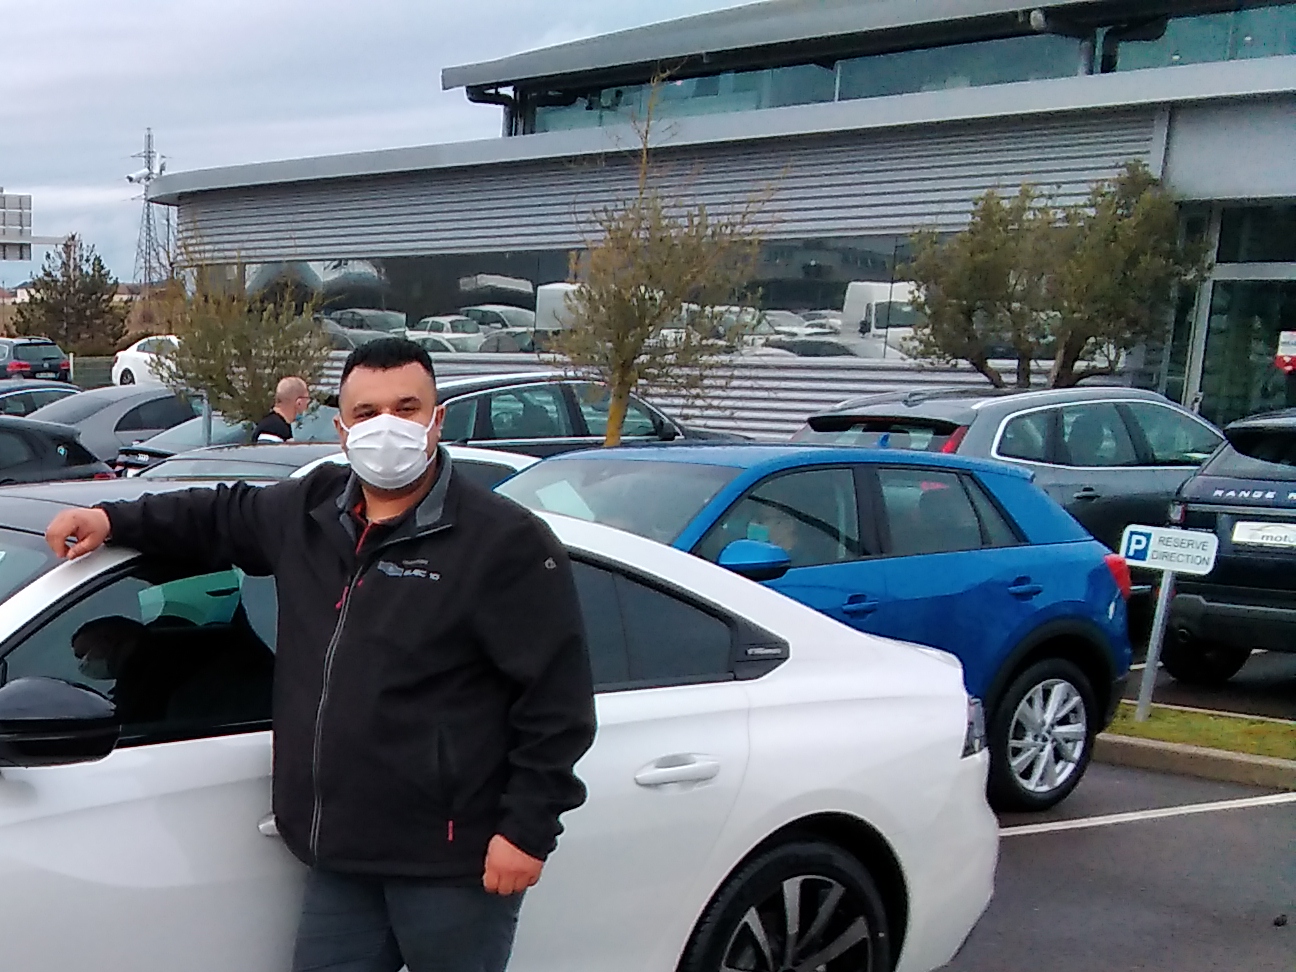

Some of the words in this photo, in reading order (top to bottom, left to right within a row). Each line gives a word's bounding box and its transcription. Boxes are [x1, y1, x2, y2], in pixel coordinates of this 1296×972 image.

[1212, 489, 1277, 500] RANGE
[1127, 533, 1147, 557] P
[1157, 535, 1210, 551] RESERVE
[1151, 550, 1211, 566] DIRECTION
